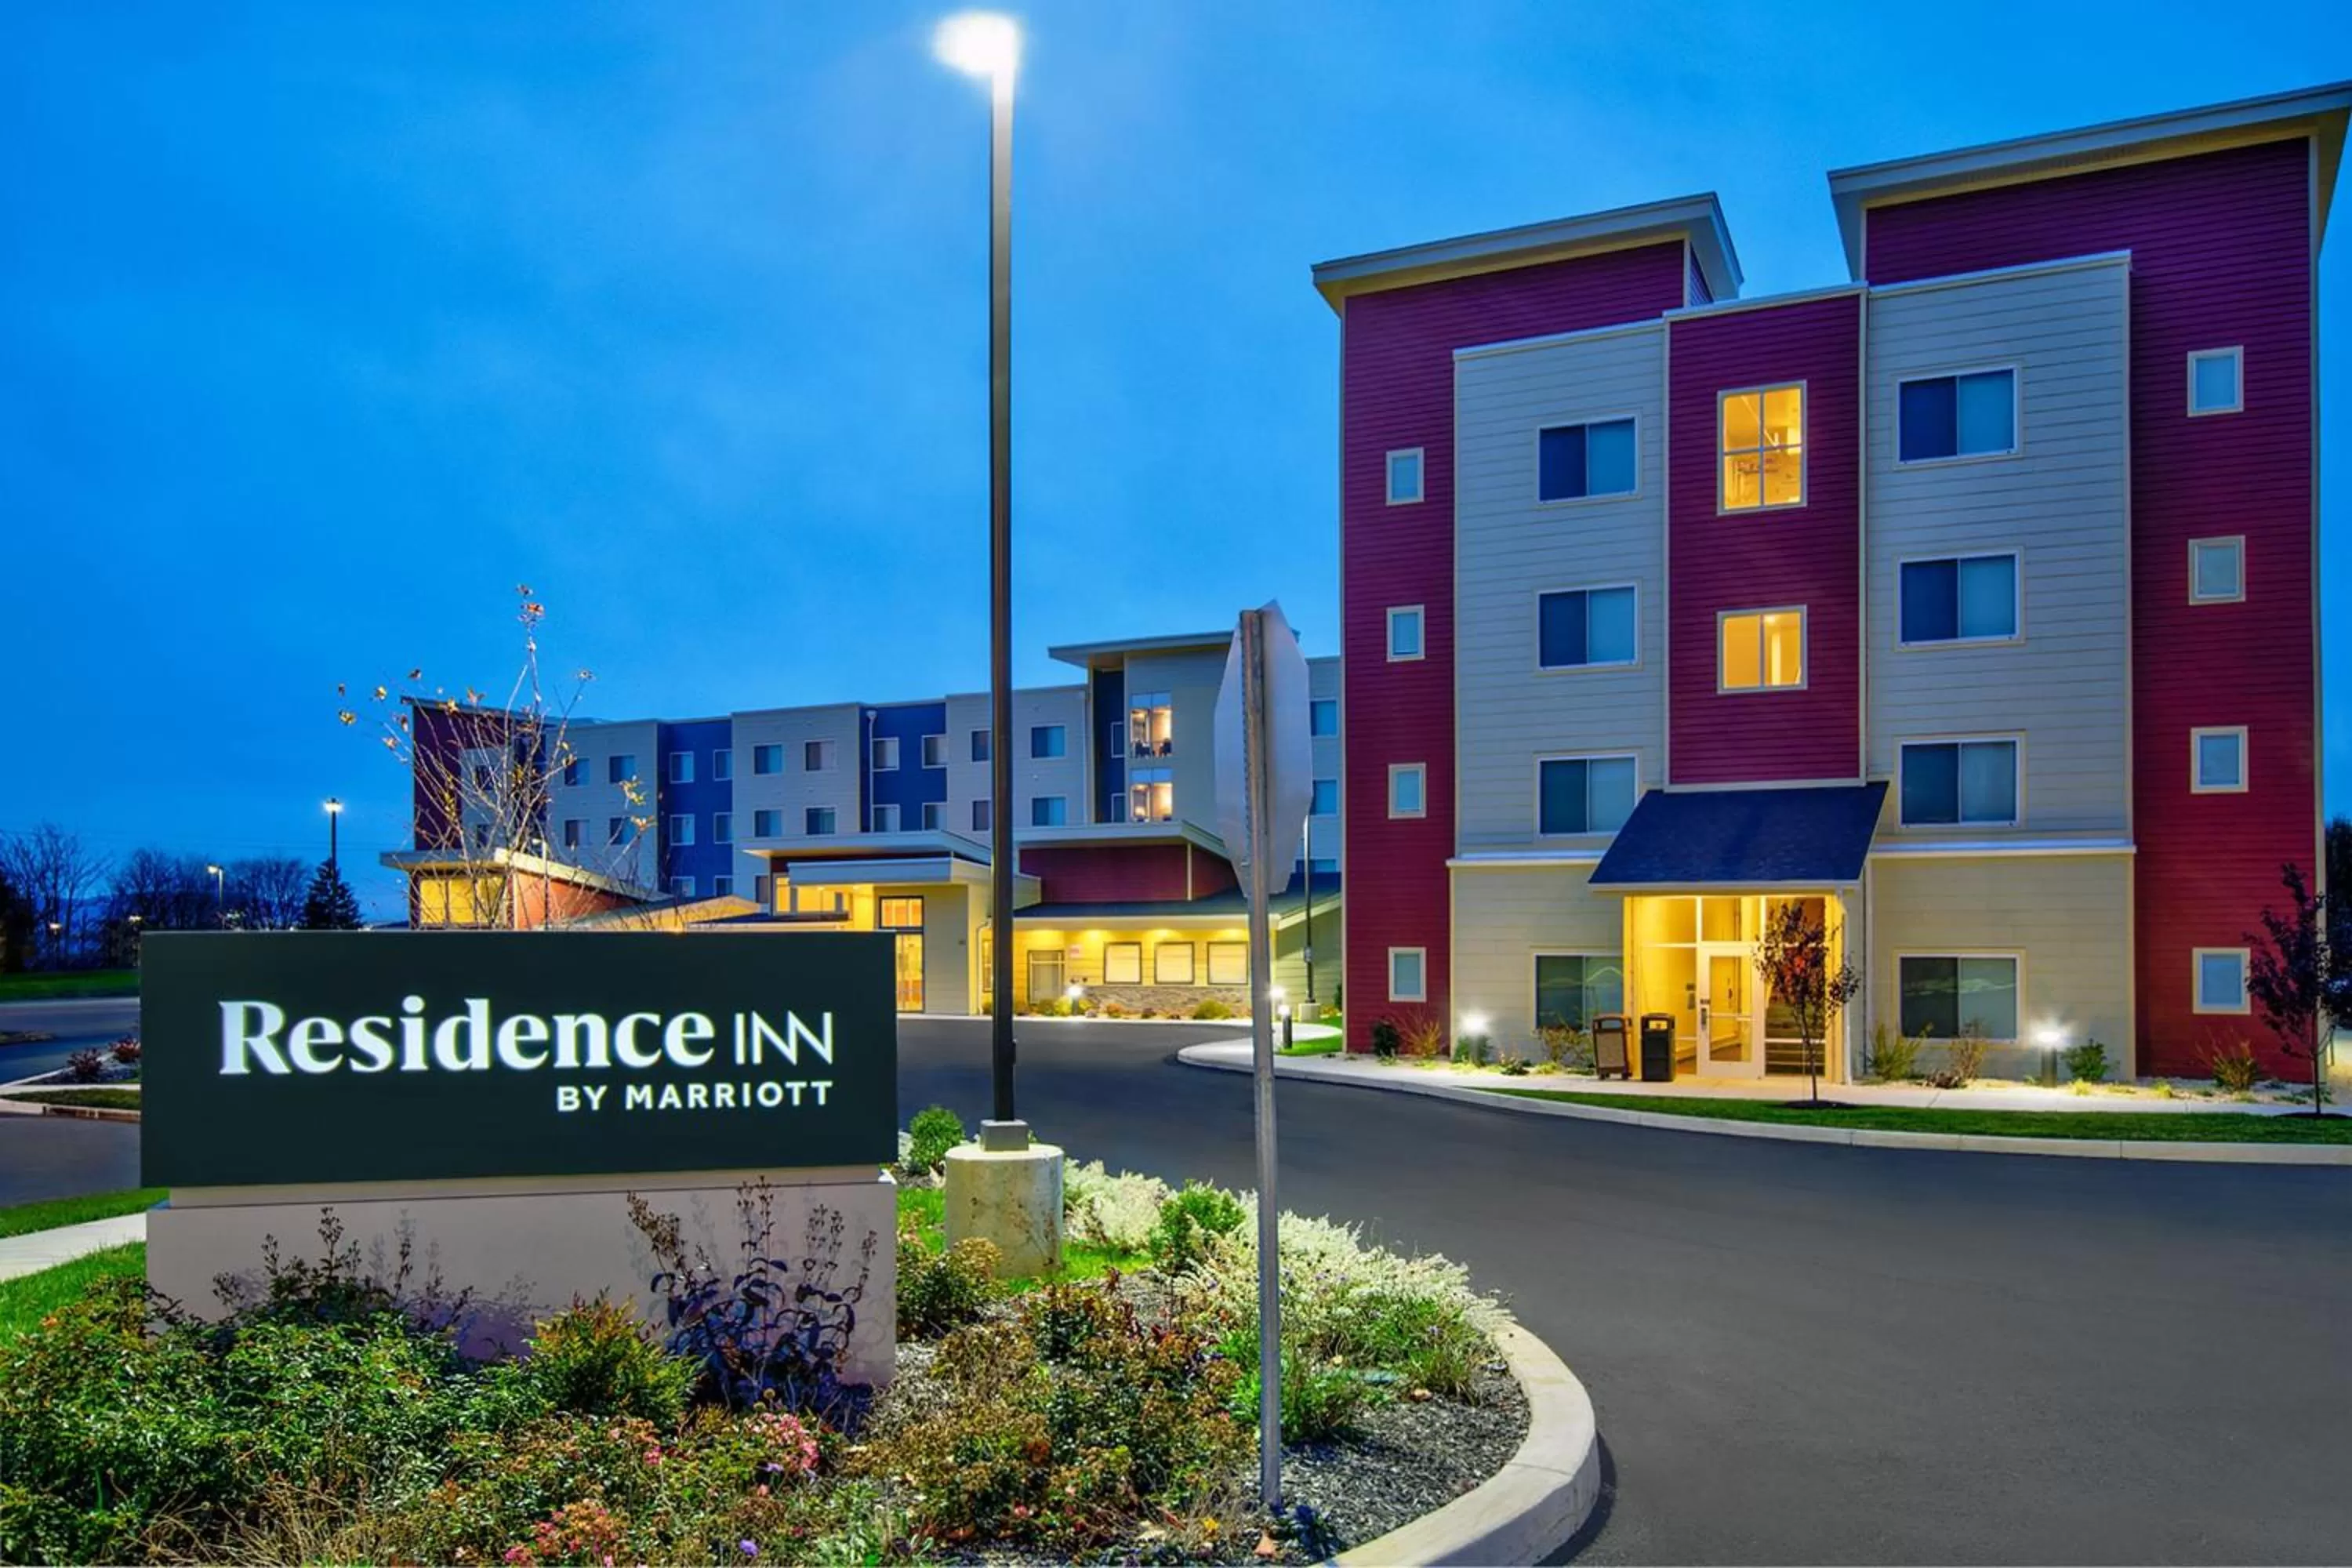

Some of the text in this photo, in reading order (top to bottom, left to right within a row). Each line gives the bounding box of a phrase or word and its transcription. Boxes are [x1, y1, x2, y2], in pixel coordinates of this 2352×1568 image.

[219, 996, 833, 1074] Residence INN
[557, 1081, 833, 1112] BY MARRIOTT
